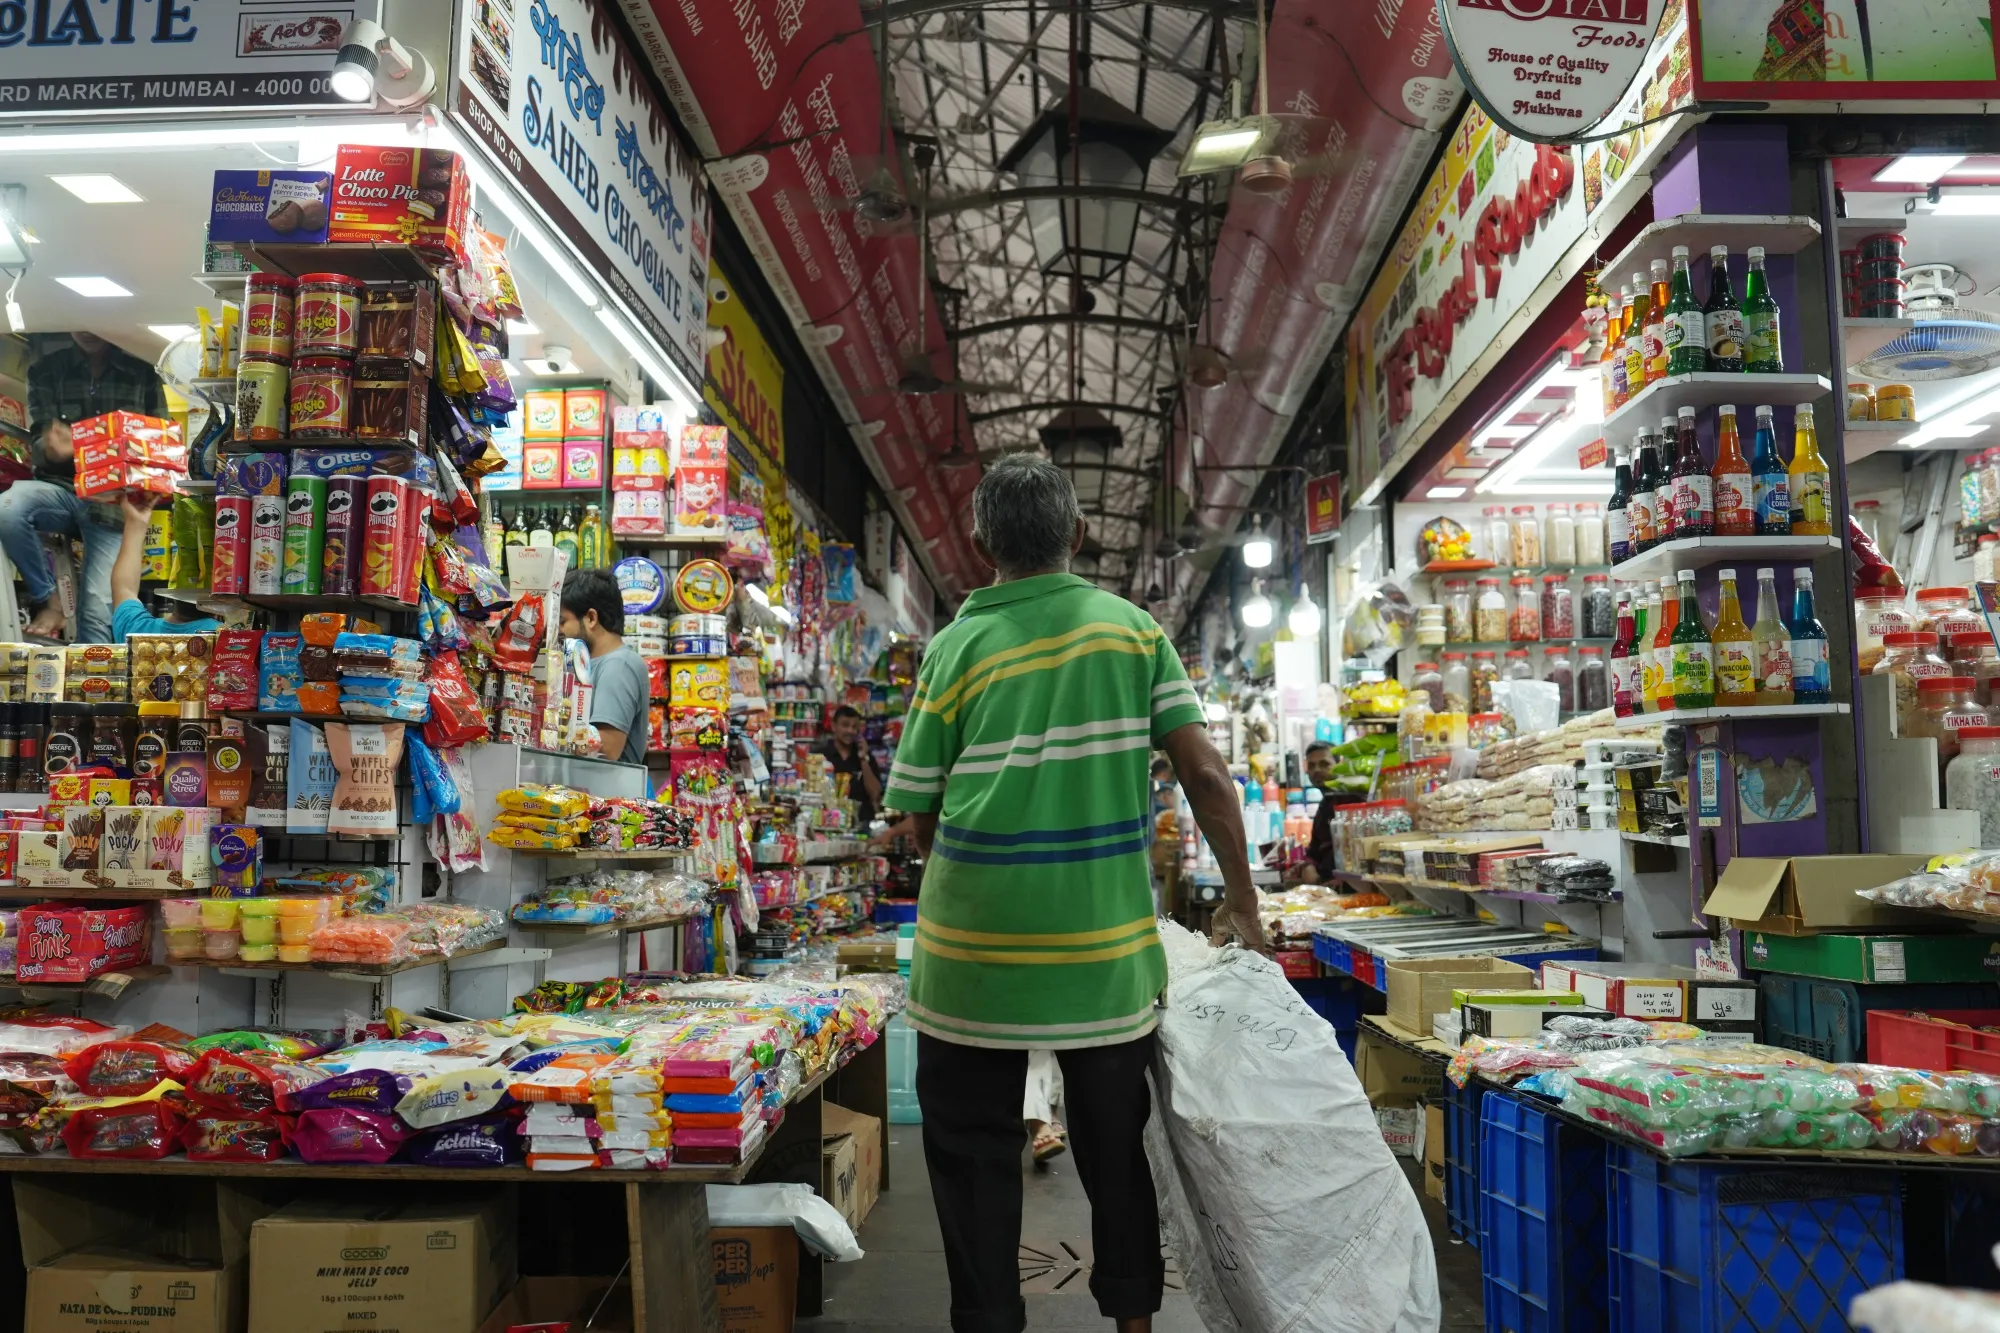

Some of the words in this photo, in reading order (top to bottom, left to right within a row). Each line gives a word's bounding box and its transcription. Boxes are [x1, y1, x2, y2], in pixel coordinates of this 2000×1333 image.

[1457, 0, 1645, 22] OYAL
[1572, 25, 1647, 49] Foods
[744, 14, 778, 91] SAHEB
[1410, 24, 1442, 69] GRAIN,
[642, 29, 667, 68] MARKET,
[660, 65, 681, 98] MUMBAI
[1487, 47, 1535, 64] House
[1538, 53, 1553, 66] of
[1556, 54, 1610, 75] Quality
[1513, 67, 1583, 87] Dryfruits
[37, 81, 136, 102] MARKET,
[143, 79, 236, 99] MUMBAI
[254, 77, 303, 96] 4000
[1535, 87, 1562, 102] and
[1512, 100, 1584, 120] Mukhwas
[467, 97, 493, 134] SHOP
[492, 129, 508, 155] NO.
[508, 151, 523, 173] 470
[522, 74, 600, 214] SAHEB
[340, 165, 386, 182] Lotte
[1353, 158, 1378, 190] STORE
[215, 187, 265, 204] Cadbury
[338, 182, 389, 199] Choco
[390, 184, 420, 201] Pie
[214, 202, 265, 213] CHOCOBAKES
[771, 188, 800, 239] PROVISION
[1394, 171, 1451, 269] Royal
[1383, 240, 1479, 428] Royal
[719, 323, 780, 461] Store
[122, 415, 146, 429] Lotte
[316, 451, 373, 470] OREO
[367, 513, 397, 529] PRINGLES
[145, 523, 163, 536] ake
[214, 528, 239, 541] PRINGLES
[254, 527, 281, 540] PRINGLES
[1943, 621, 1977, 633] WEFFAR
[1685, 670, 1708, 678] PUDINA
[1686, 663, 1706, 672] LEMON
[1907, 665, 1931, 676] GINGER
[1945, 715, 1971, 727] TIKHA
[698, 733, 722, 746] Spicy
[265, 755, 289, 768] WAF
[308, 754, 332, 768] WAF
[350, 757, 390, 769] WAFFLE
[169, 774, 202, 785] Quality
[351, 769, 390, 784] CHIPS
[171, 783, 199, 794] Street
[33, 914, 63, 936] SOUR
[28, 932, 71, 962] PUNK
[344, 1249, 385, 1259] COCON
[712, 1242, 749, 1259] PER
[316, 1267, 342, 1277] MINI
[342, 1266, 367, 1277] NATA
[368, 1266, 382, 1276] DE
[383, 1265, 410, 1276] COCO
[347, 1277, 378, 1289] JELLY
[343, 1294, 377, 1304] 100cups
[383, 1293, 405, 1302] 6pkts
[59, 1303, 86, 1315] NATA
[87, 1303, 102, 1315] DE
[130, 1305, 177, 1318] PUDDING
[347, 1311, 378, 1321] MIXED
